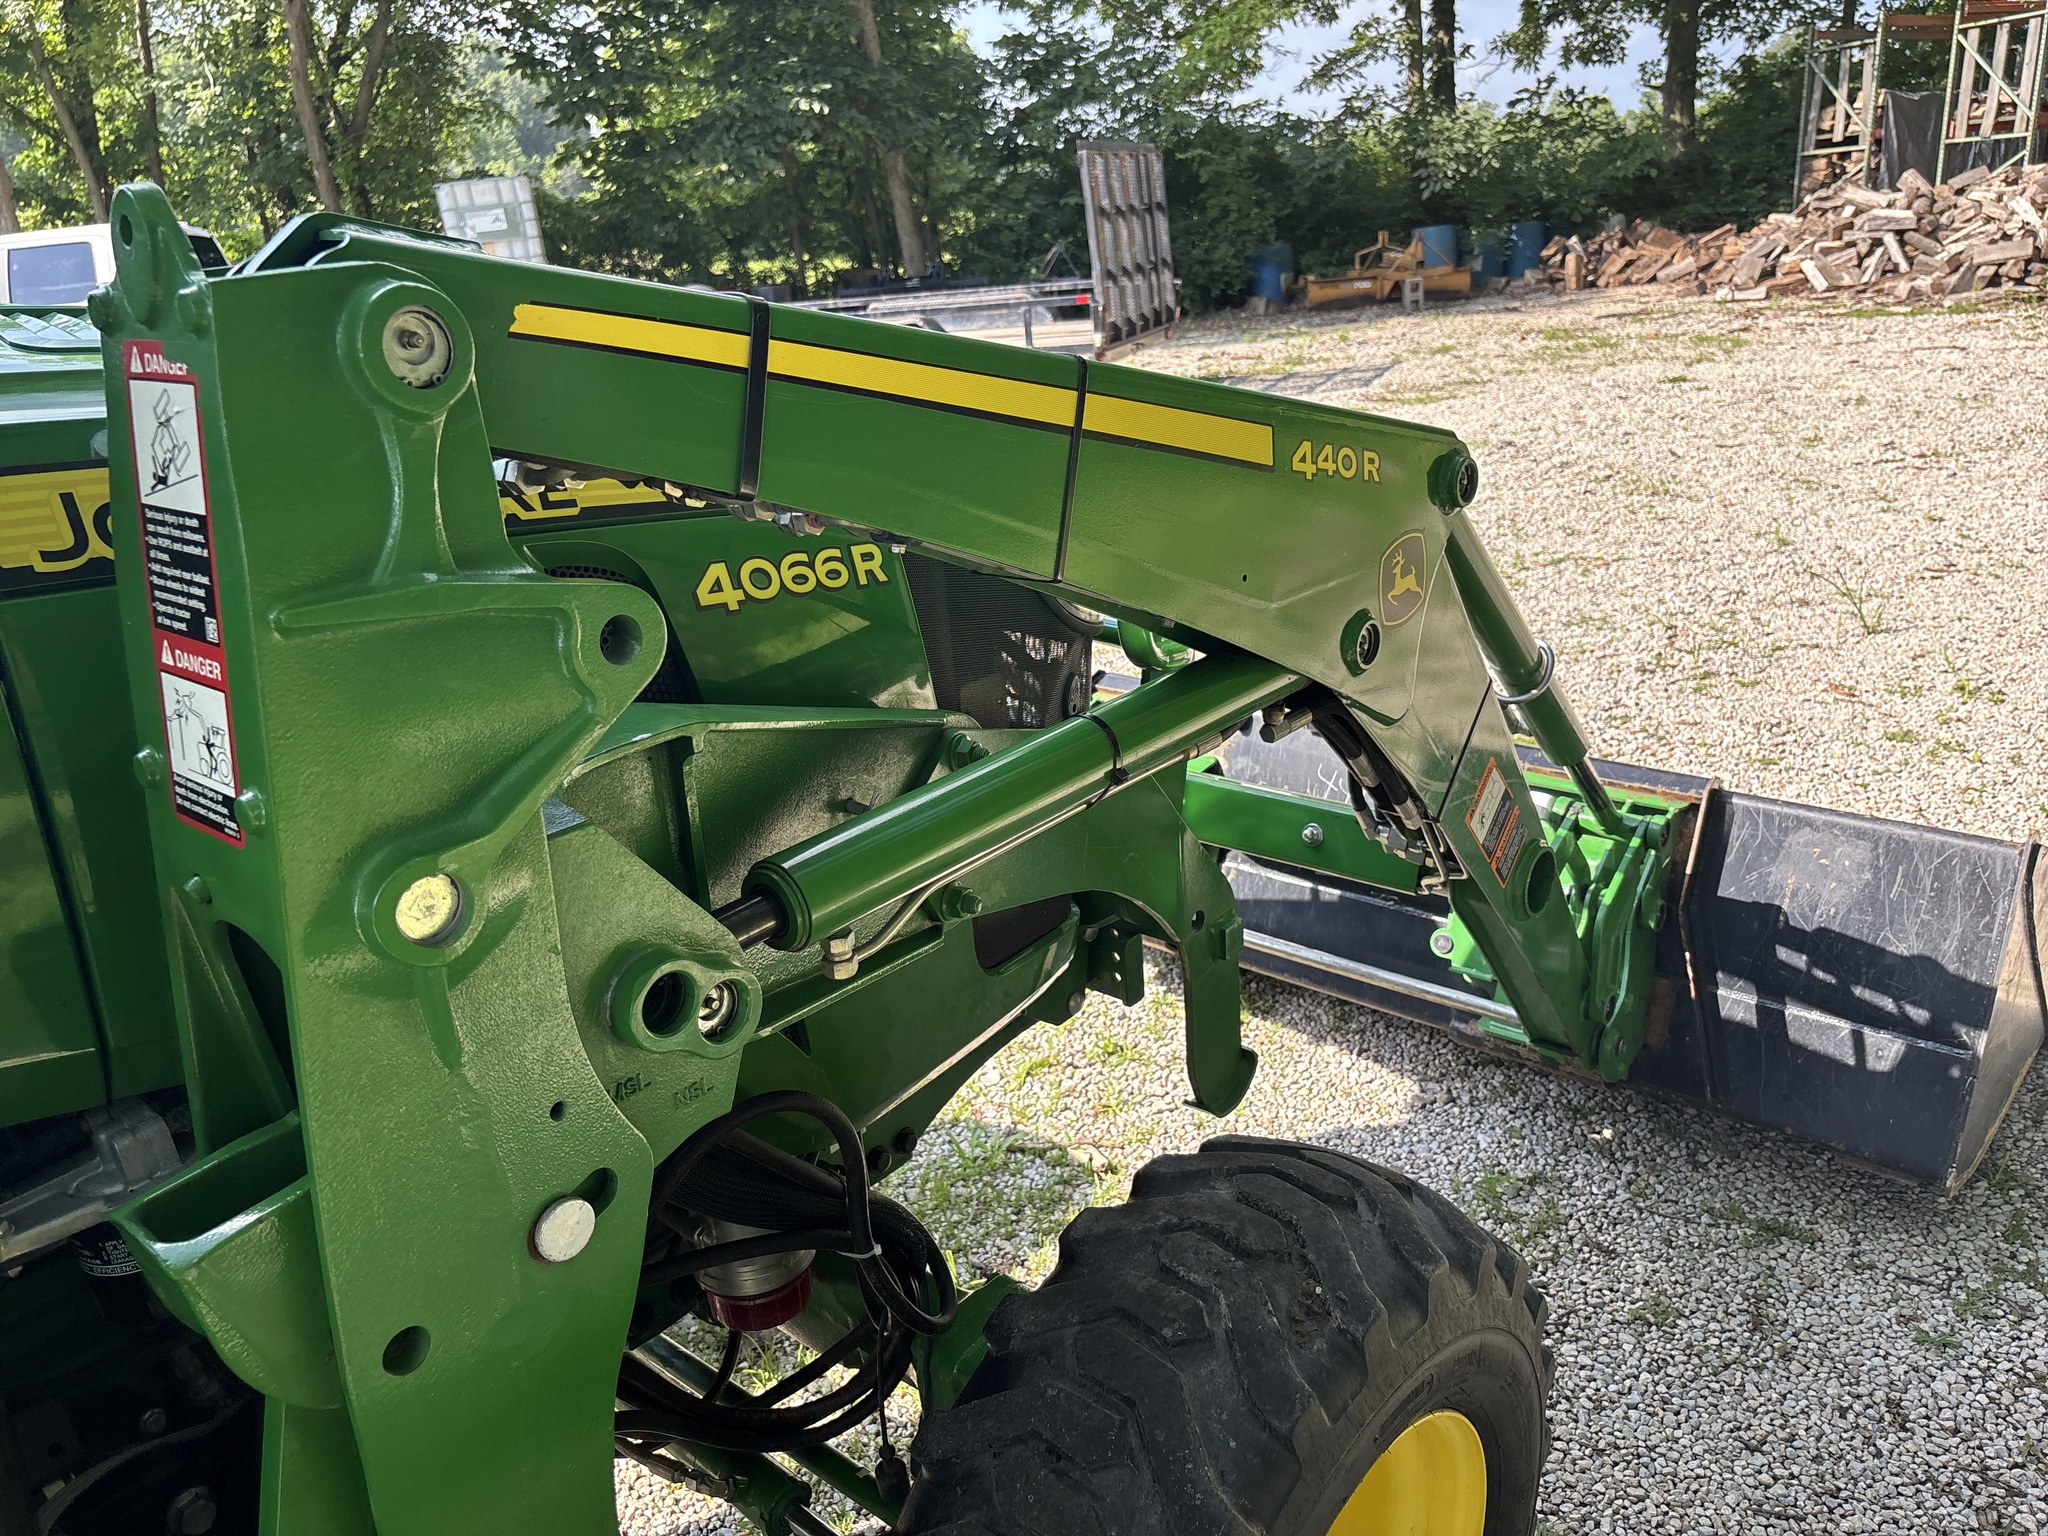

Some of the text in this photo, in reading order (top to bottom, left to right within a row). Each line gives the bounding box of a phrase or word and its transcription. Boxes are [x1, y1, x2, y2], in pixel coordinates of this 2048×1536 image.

[144, 508, 164, 520] Serious
[163, 512, 178, 525] injury
[185, 516, 200, 527] death
[156, 526, 171, 535] result
[170, 526, 182, 537] from
[162, 566, 182, 577] required
[166, 579, 183, 591] wheels
[175, 649, 222, 681] DANGER
[175, 785, 187, 796] death
[187, 789, 198, 800] from
[186, 780, 204, 793] serious
[203, 786, 217, 802] injury
[191, 803, 209, 817] contact
[208, 810, 226, 824] electric
[1499, 812, 1518, 852] WARNING
